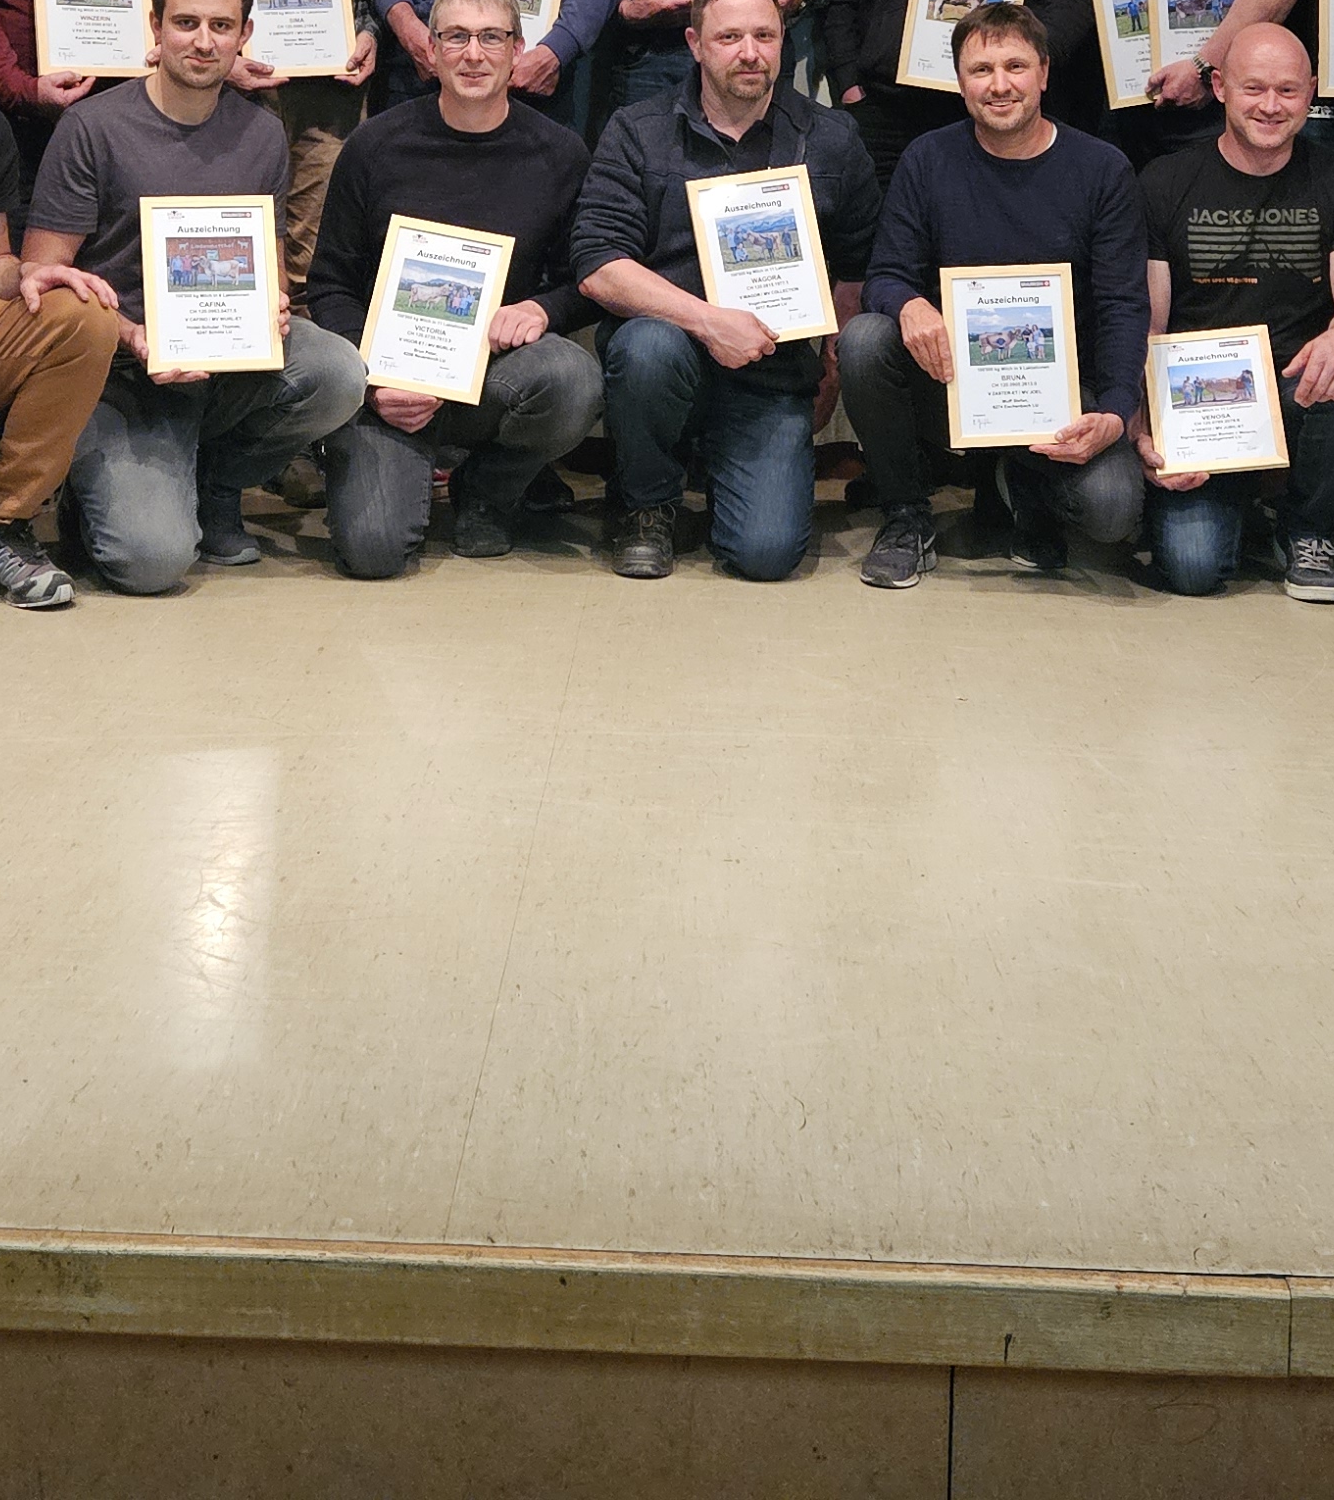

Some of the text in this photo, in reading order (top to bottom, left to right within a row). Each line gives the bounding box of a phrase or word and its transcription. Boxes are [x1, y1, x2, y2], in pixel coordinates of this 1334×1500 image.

[725, 200, 782, 213] Auszeichnung
[1188, 208, 1320, 225] JACK&JONES
[417, 250, 477, 268] Auszeichnung
[751, 274, 781, 283] WAGORA
[977, 296, 1039, 305] Auszeichnung
[415, 325, 446, 336] VICTORIA
[1178, 352, 1238, 363] Auszeichnung
